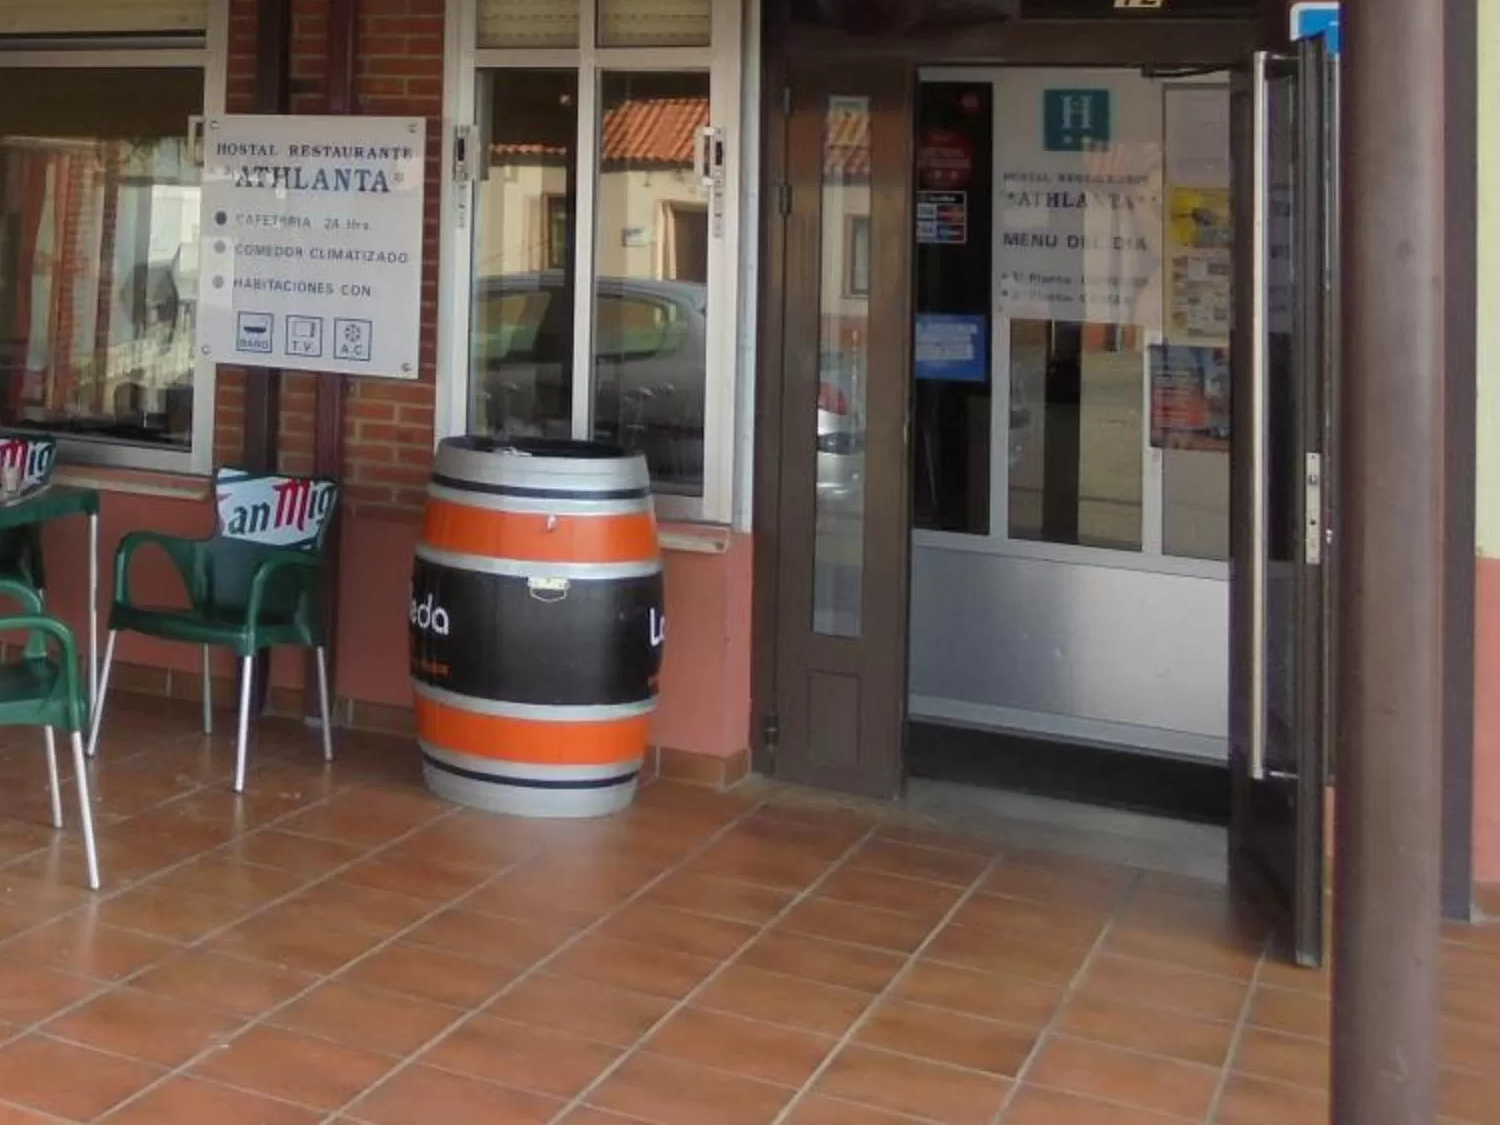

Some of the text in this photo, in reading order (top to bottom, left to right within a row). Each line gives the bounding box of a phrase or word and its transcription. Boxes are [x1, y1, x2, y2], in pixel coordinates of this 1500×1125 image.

[216, 142, 413, 160] HOSTAL RESTAURANTE
[234, 166, 391, 193] ATHLANTA
[235, 243, 409, 264] COMEDOR CLIMATIZADO
[233, 277, 371, 297] HABITACIONES CON
